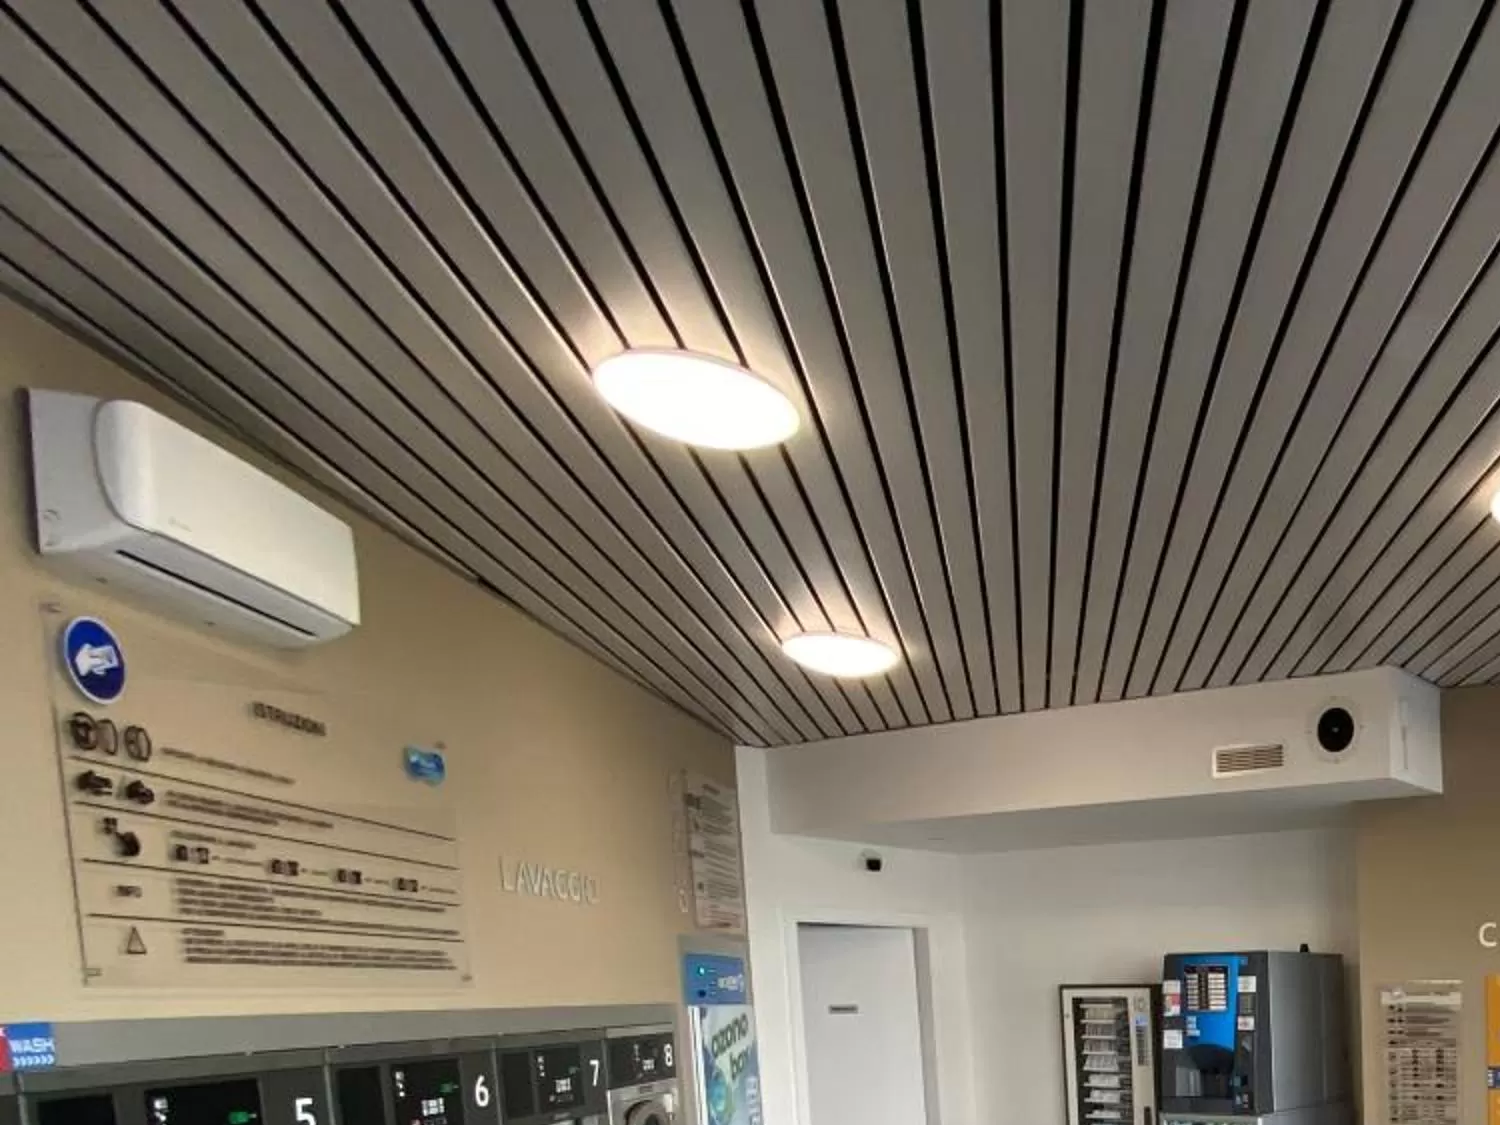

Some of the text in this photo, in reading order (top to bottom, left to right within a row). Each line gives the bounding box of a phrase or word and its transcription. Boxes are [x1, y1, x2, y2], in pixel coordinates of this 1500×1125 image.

[9, 1036, 56, 1053] WASH
[711, 1011, 749, 1059] ozono
[663, 1043, 674, 1067] 8
[589, 1058, 601, 1087] 7
[474, 1074, 490, 1108] 6
